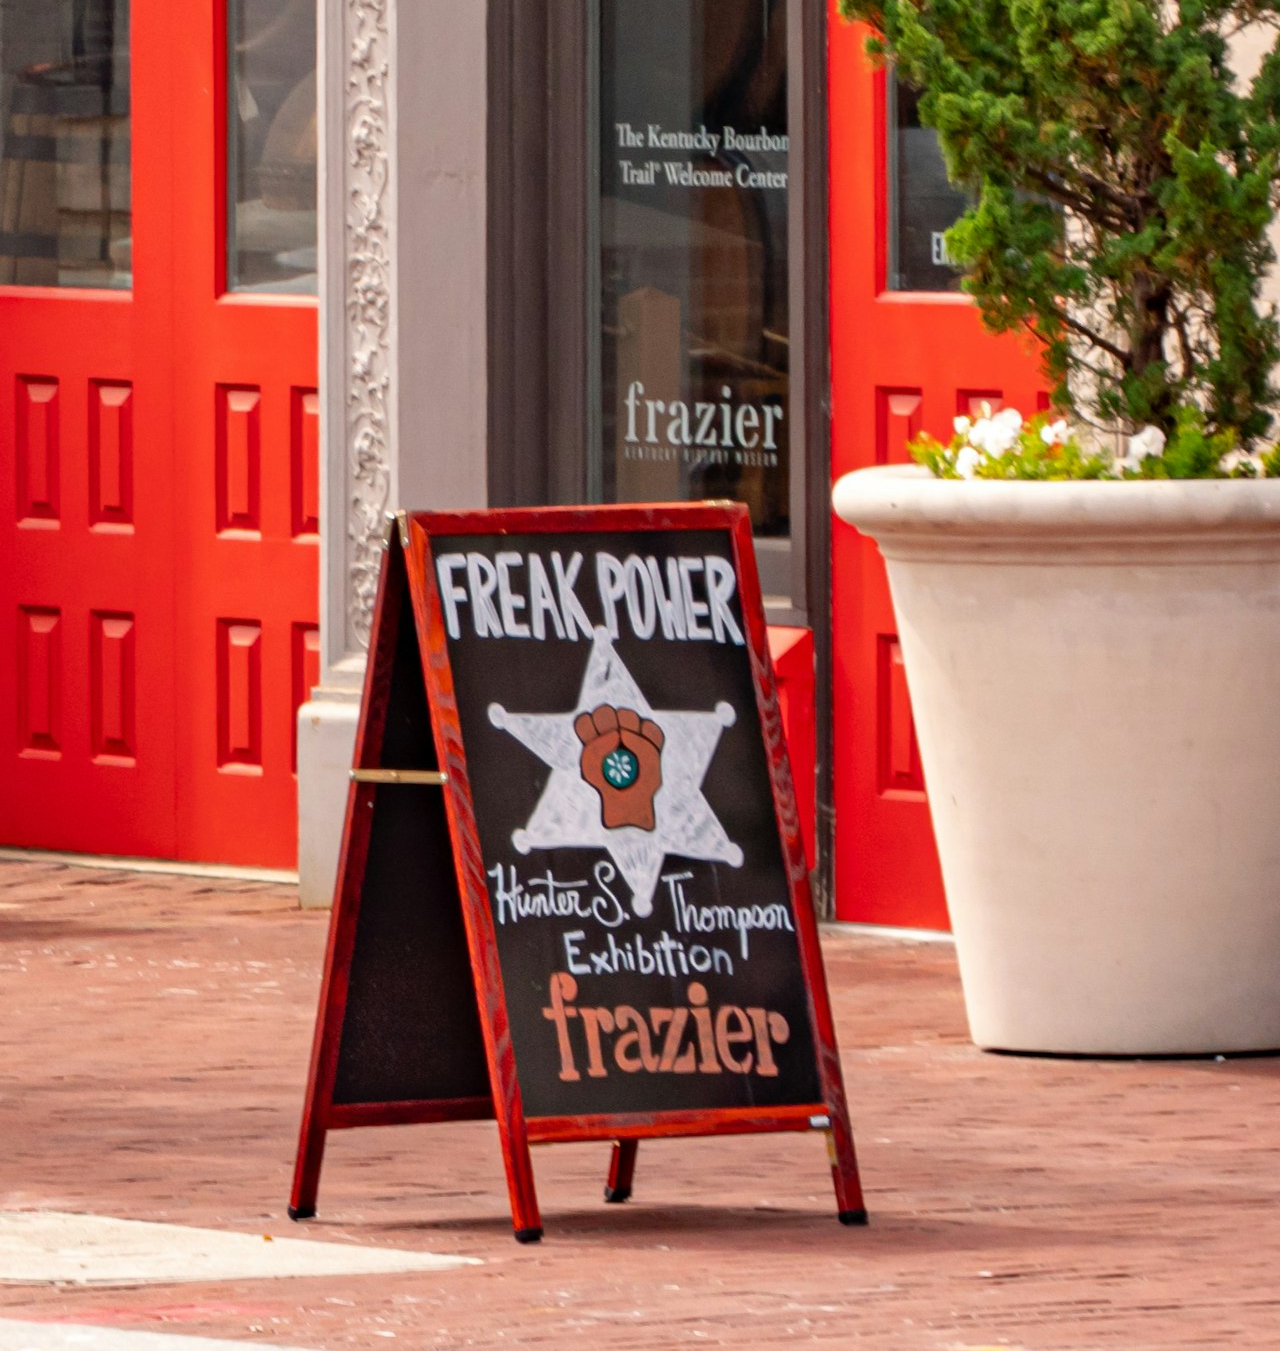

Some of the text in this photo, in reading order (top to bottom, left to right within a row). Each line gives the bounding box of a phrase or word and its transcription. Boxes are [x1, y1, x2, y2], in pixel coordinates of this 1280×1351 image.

[616, 122, 644, 148] The
[647, 123, 721, 158] Kentucky
[663, 161, 733, 187] Welcome
[735, 163, 788, 189] Center
[624, 381, 784, 450] frazier
[436, 551, 746, 646] FREAK POWER
[488, 862, 591, 925] Hunter
[661, 871, 795, 960] Thompson
[563, 930, 734, 977] Exhibition
[542, 971, 790, 1082] frazier
